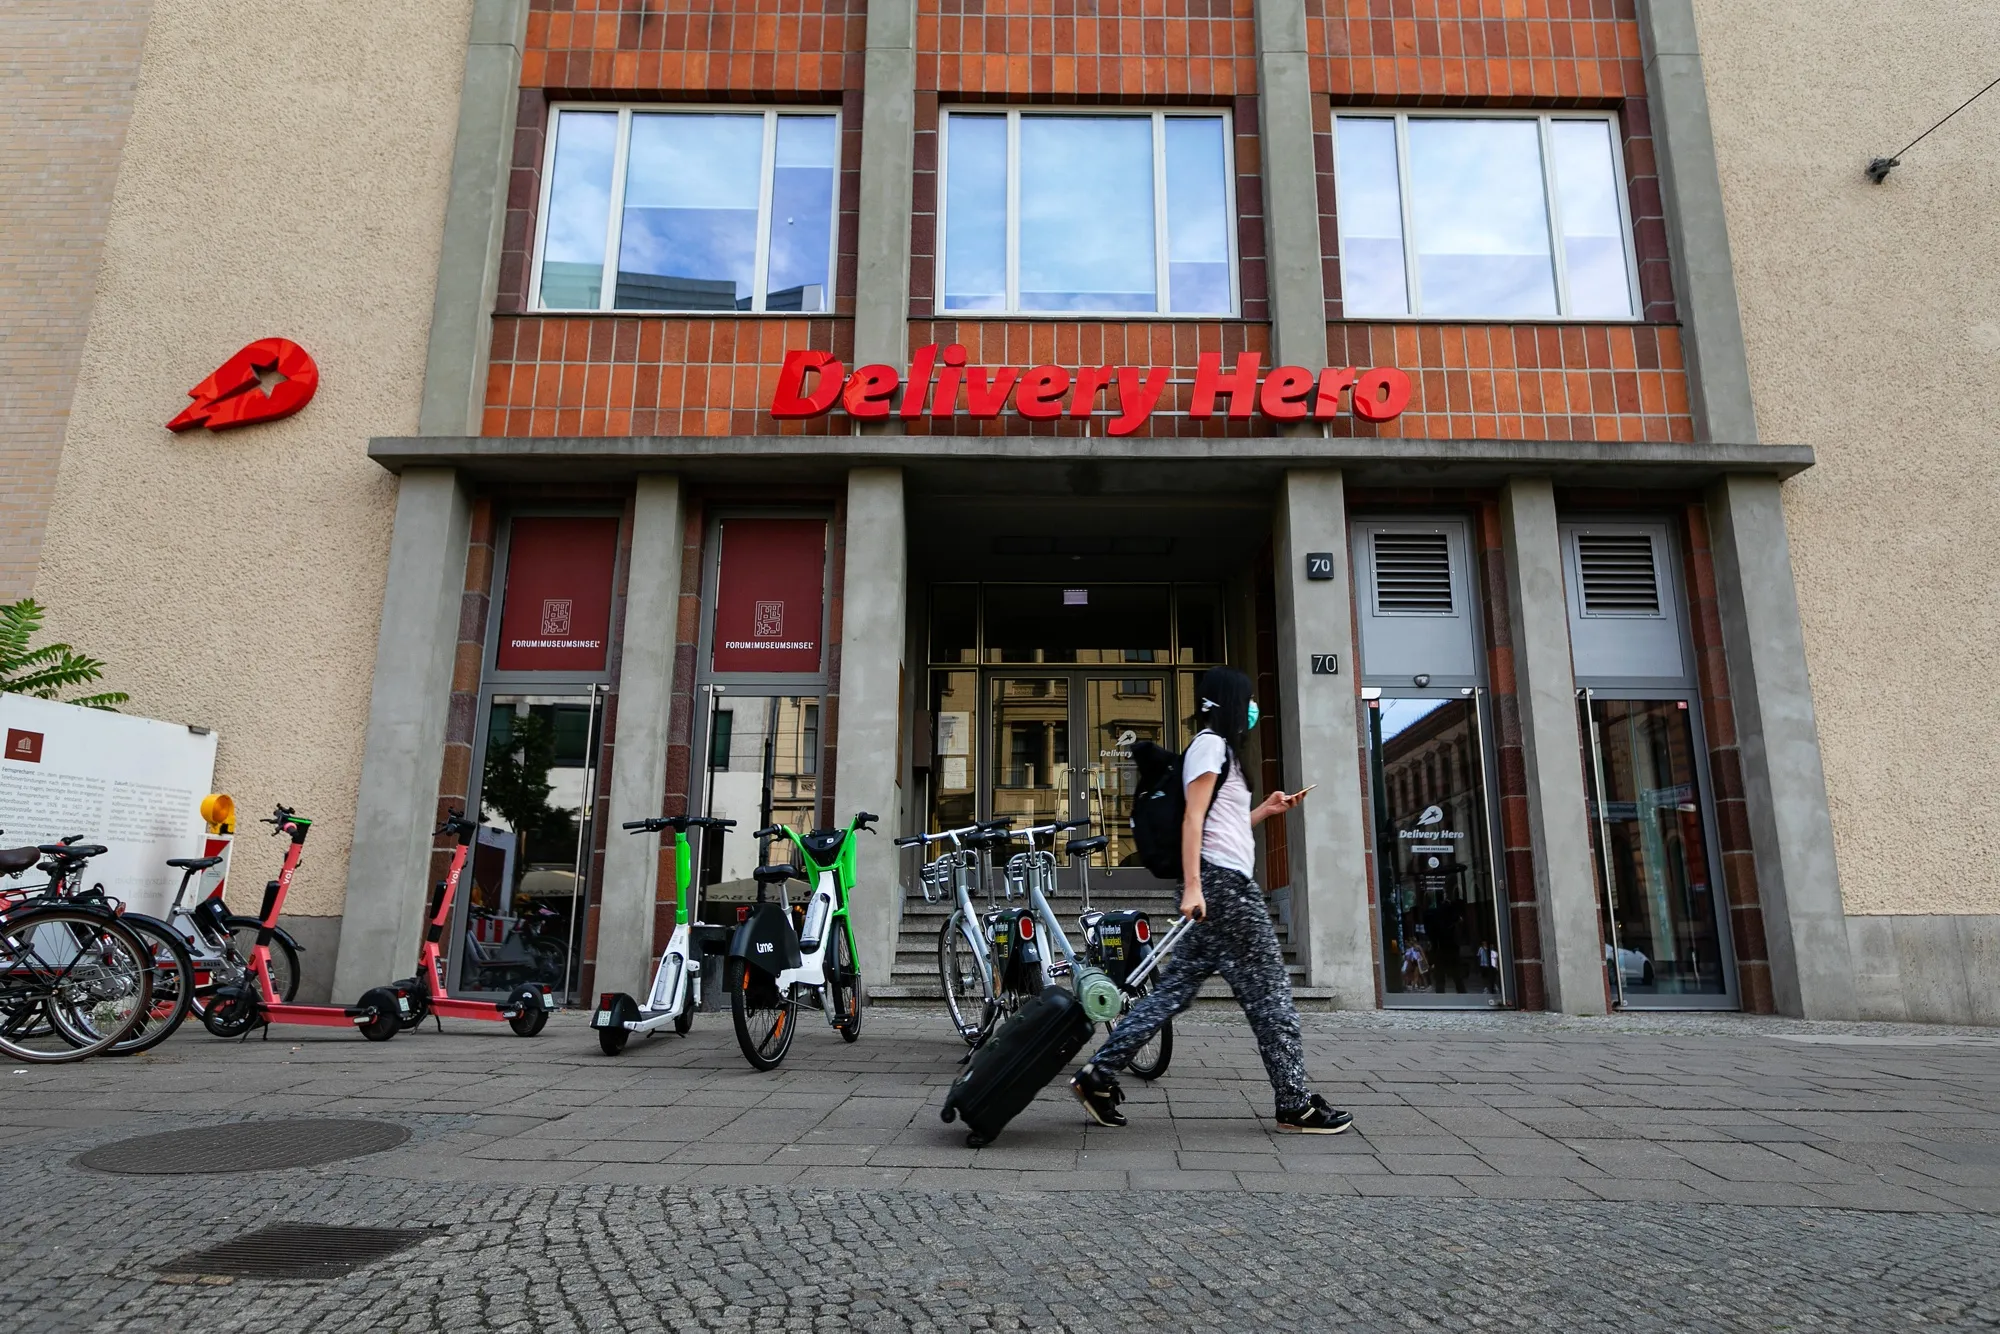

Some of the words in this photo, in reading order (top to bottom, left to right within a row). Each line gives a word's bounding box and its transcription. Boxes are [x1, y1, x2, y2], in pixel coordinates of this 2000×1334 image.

[769, 343, 1170, 437] Delivery
[1188, 351, 1412, 424] Hero
[1311, 559, 1330, 572] 70
[1313, 655, 1337, 673] 70
[1100, 750, 1133, 758] Delivery
[1399, 829, 1440, 840] Delivery
[1440, 830, 1464, 838] Hero
